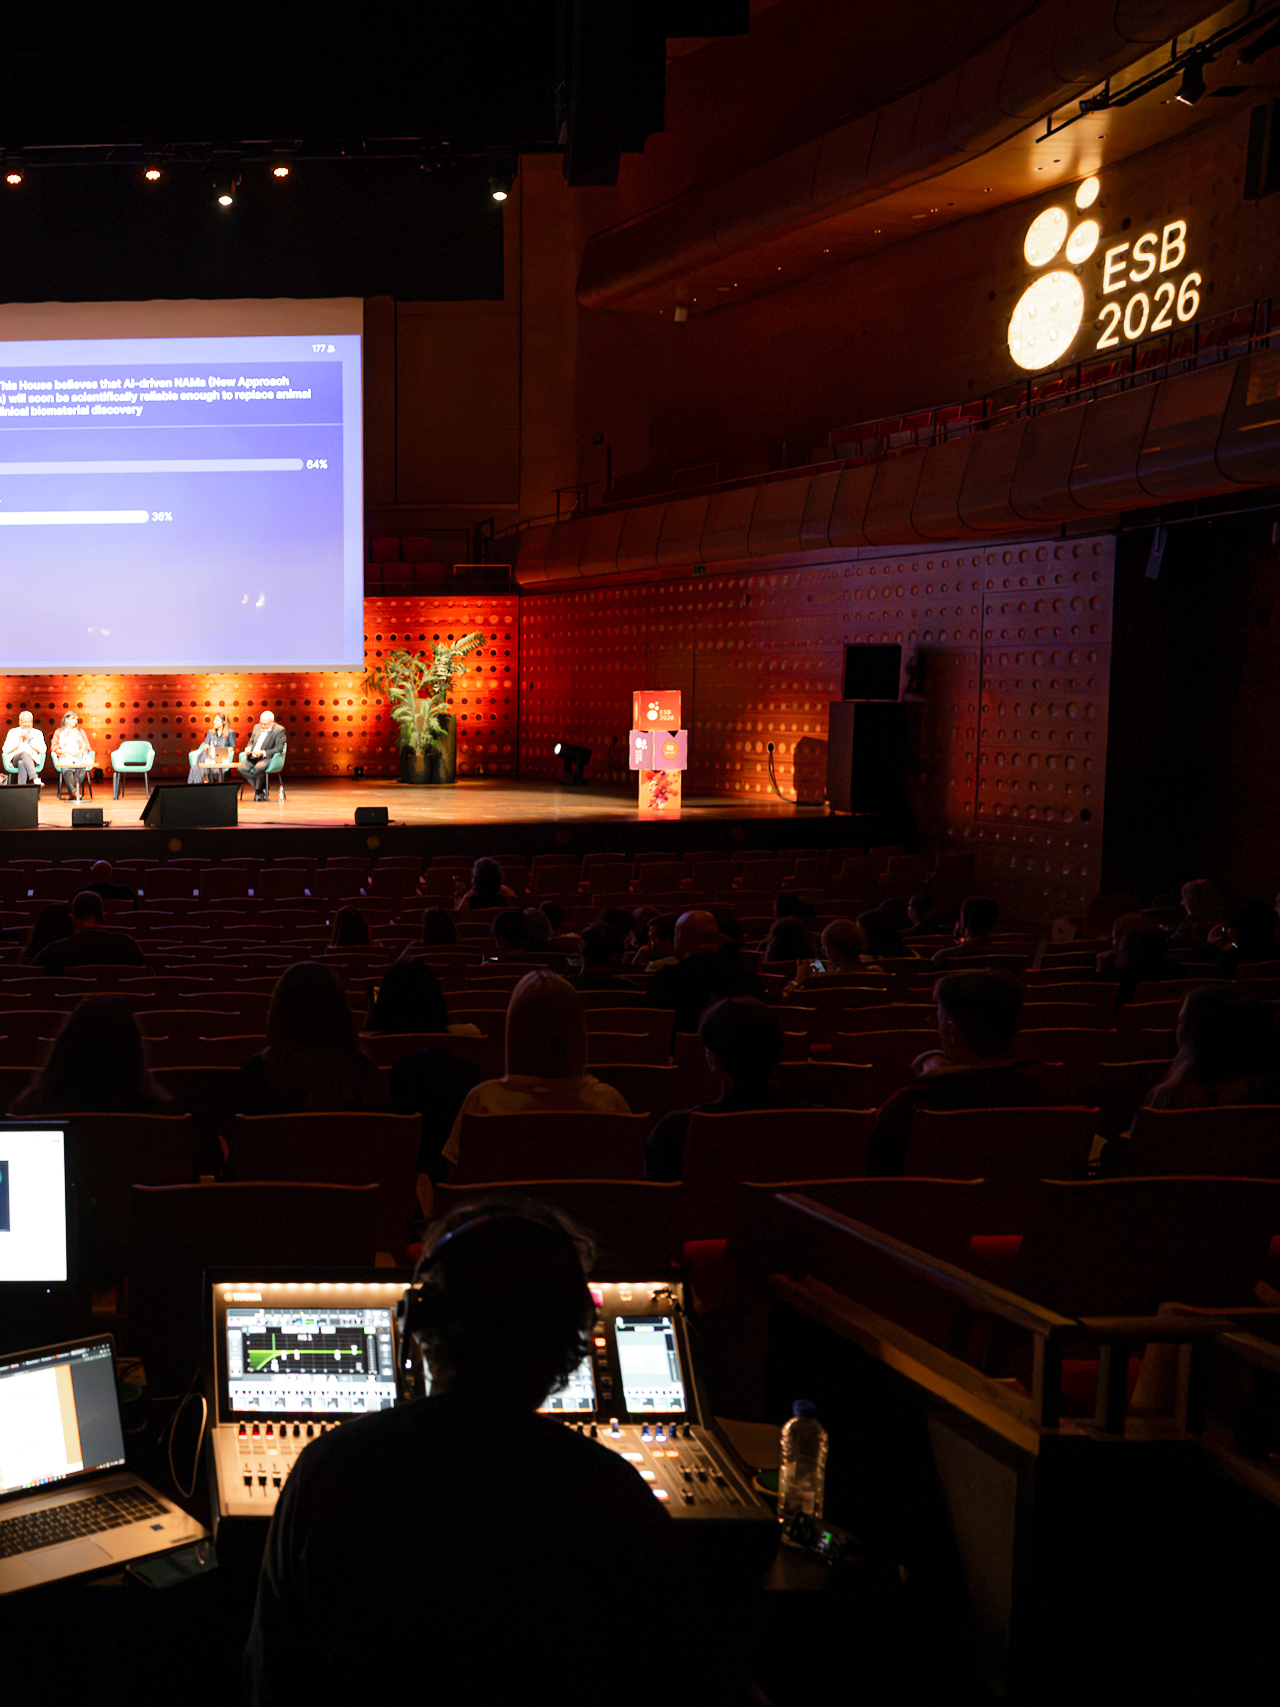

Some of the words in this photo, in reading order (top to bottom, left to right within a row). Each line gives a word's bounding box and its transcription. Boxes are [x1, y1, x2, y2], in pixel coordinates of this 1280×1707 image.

[1102, 219, 1187, 294] ESB
[1095, 271, 1202, 350] 2026
[312, 344, 326, 353] 177
[19, 380, 53, 391] House
[54, 379, 98, 390] believes
[100, 378, 122, 390] that
[123, 378, 172, 389] AI-driven
[174, 377, 206, 388] NAMs
[208, 376, 236, 388] (New
[238, 376, 290, 389] Approach
[8, 394, 26, 404] will
[28, 395, 54, 404] soon
[56, 392, 70, 404] be
[71, 391, 138, 404] scientifically
[140, 390, 178, 402] reliable
[180, 390, 220, 403] enough
[222, 390, 234, 400] to
[235, 389, 274, 402] replace
[276, 388, 312, 400] animal
[31, 405, 90, 416] biomaterial
[91, 404, 143, 416] discovery
[306, 459, 328, 470] 64%
[152, 510, 173, 522] 36%
